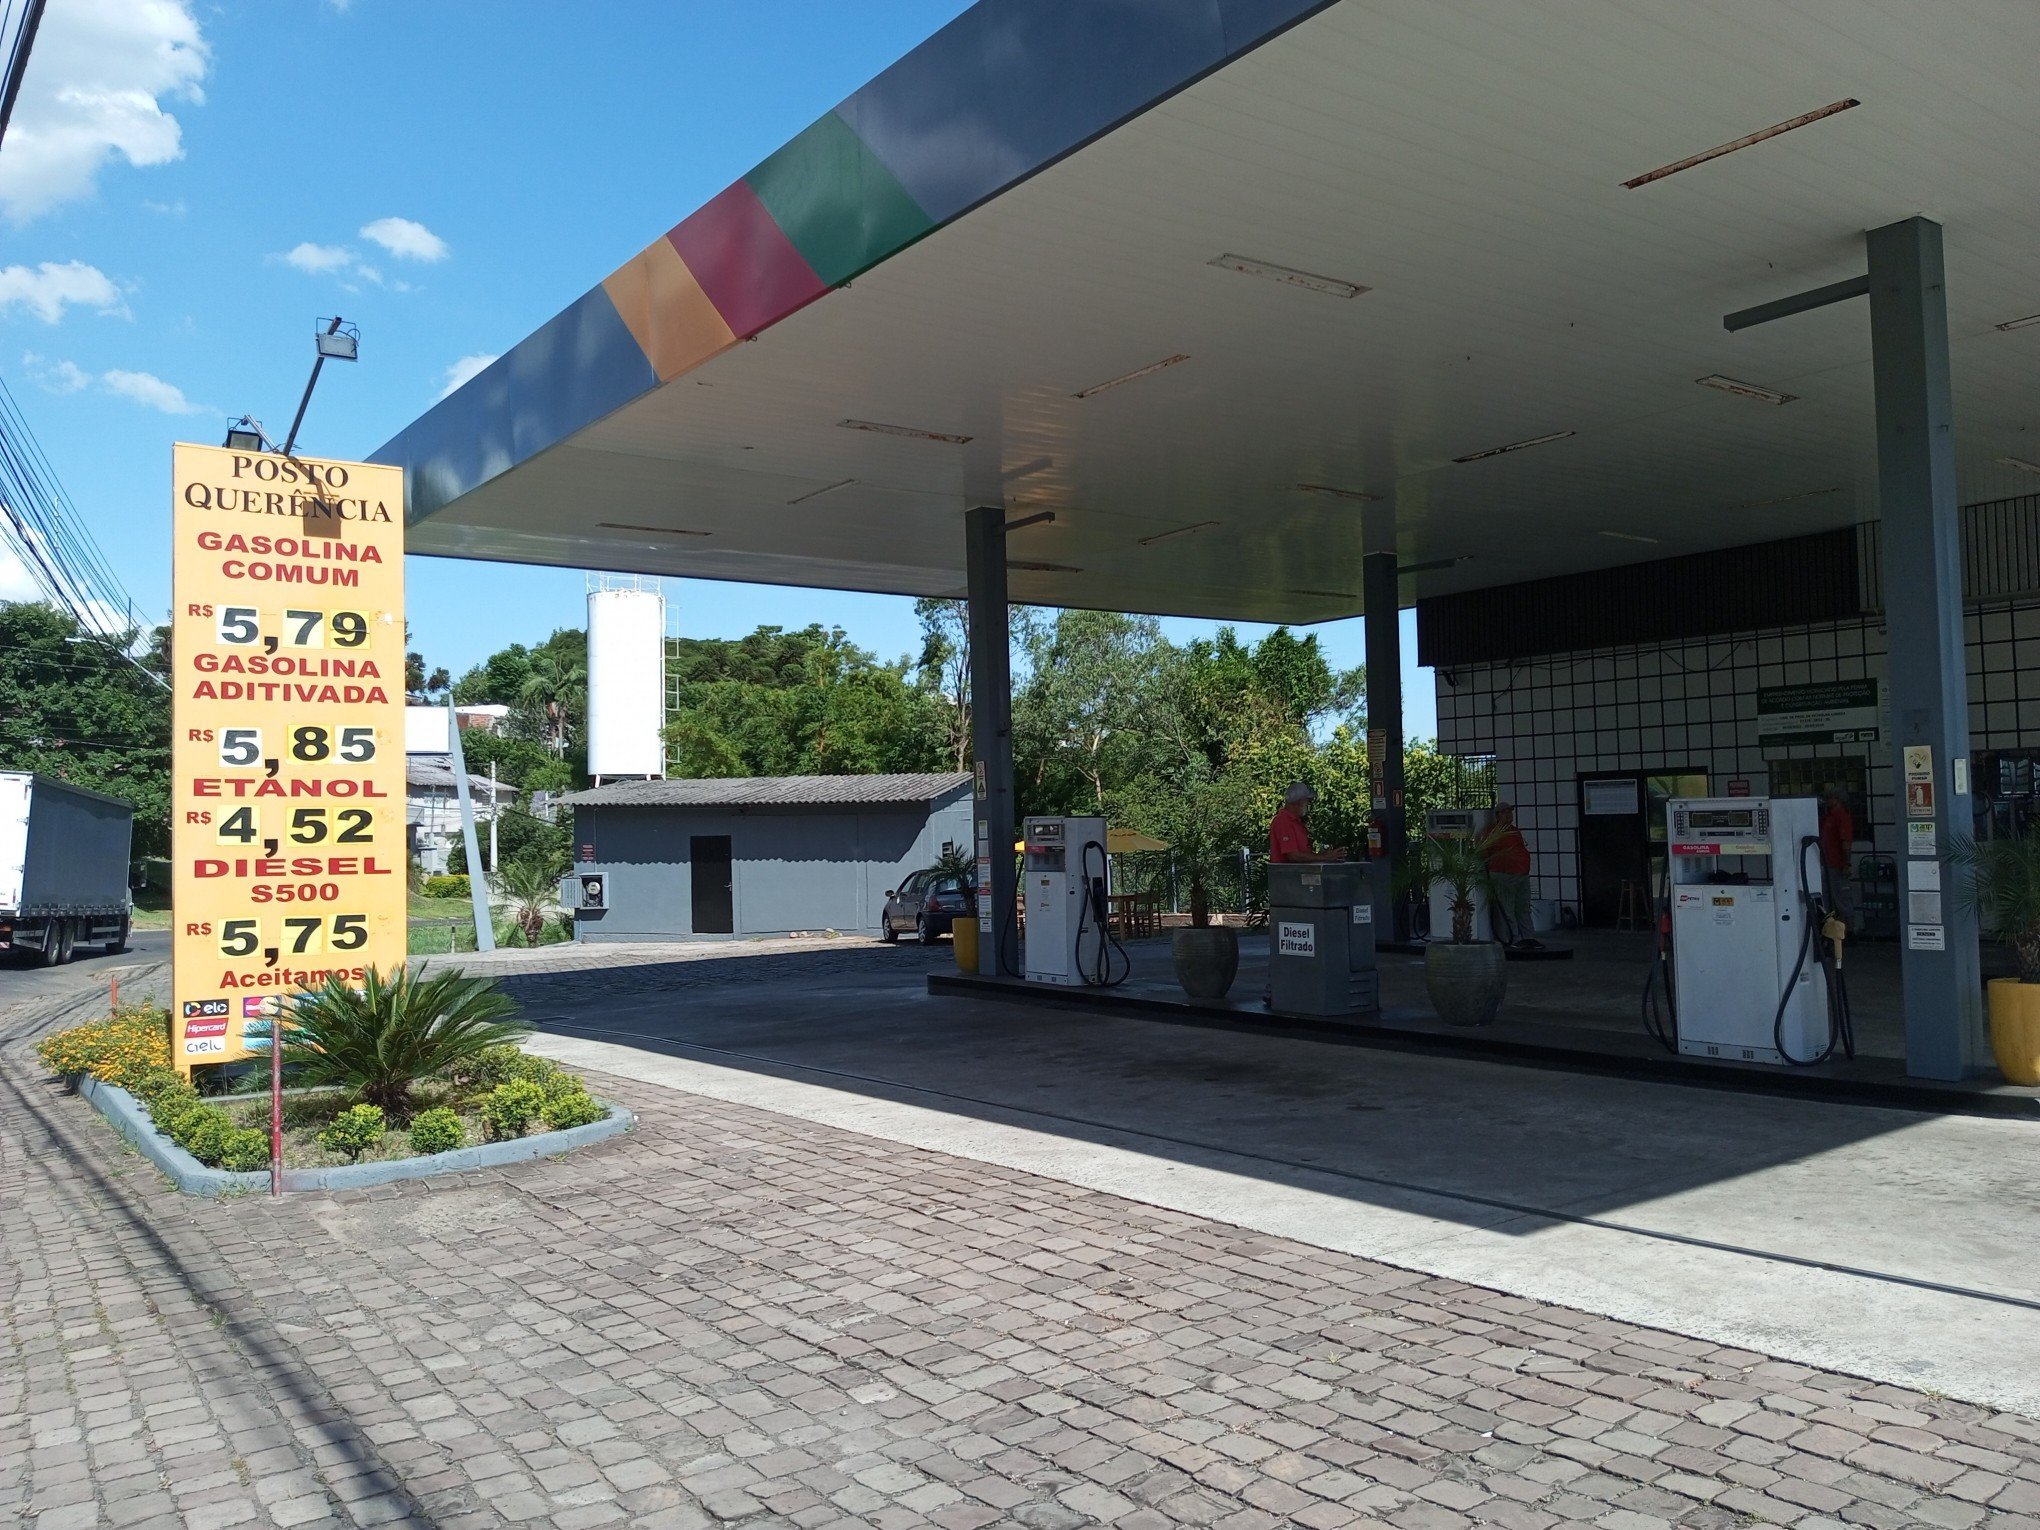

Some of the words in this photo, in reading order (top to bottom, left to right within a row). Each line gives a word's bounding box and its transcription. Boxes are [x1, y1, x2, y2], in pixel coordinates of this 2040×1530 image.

[232, 455, 349, 489] POSTO
[184, 482, 393, 523] QUERÊNCIA
[197, 531, 383, 564] GASOLINA
[222, 560, 359, 587] COMUM
[188, 603, 214, 619] R$
[221, 607, 367, 655] 5,79
[193, 653, 381, 678] GASOLINA
[192, 680, 389, 704] ADITIVADA
[188, 729, 214, 743] R$
[221, 726, 376, 778] 5,85
[193, 779, 388, 798] ETANOL
[186, 811, 212, 825] R$
[219, 806, 374, 858] 4,52
[193, 857, 392, 878] DIESEL
[250, 882, 339, 903] S500
[186, 922, 212, 937] R$
[220, 914, 368, 967] 5,75
[1283, 926, 1310, 939] Diesel
[1280, 939, 1314, 952] Filtrado
[219, 967, 365, 989] Aceitamos
[187, 1022, 226, 1034] Hipercard
